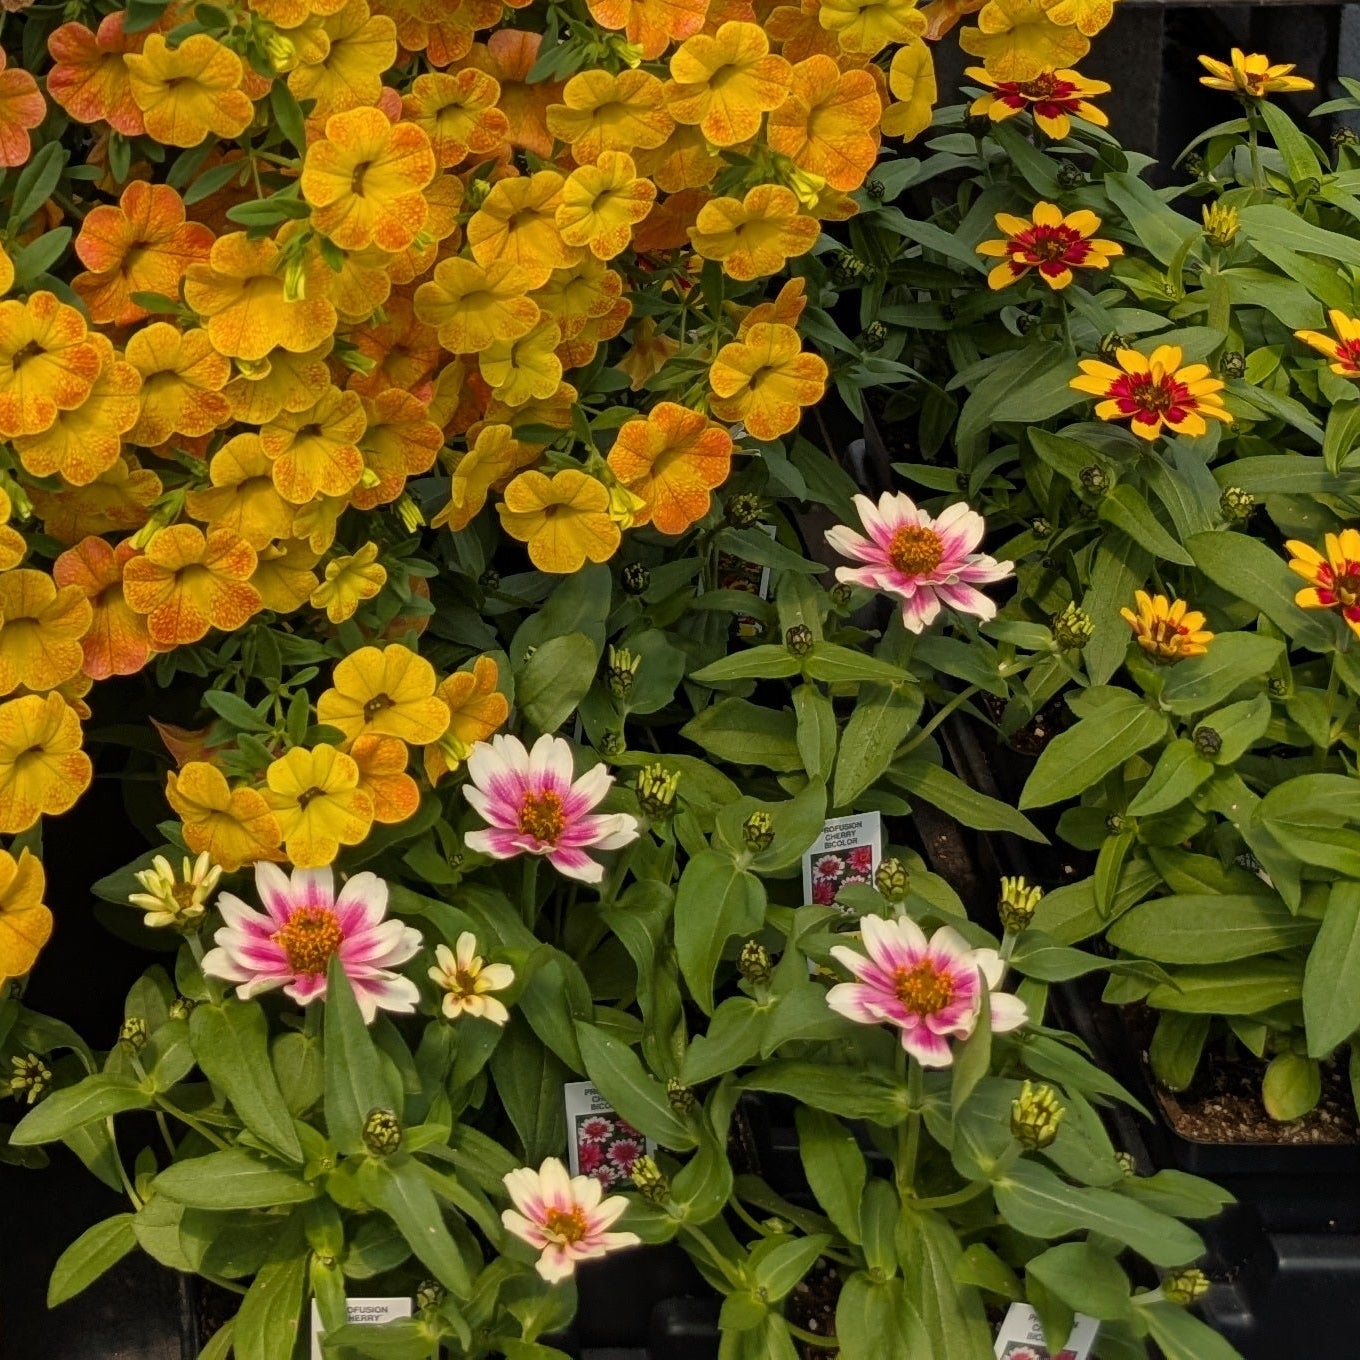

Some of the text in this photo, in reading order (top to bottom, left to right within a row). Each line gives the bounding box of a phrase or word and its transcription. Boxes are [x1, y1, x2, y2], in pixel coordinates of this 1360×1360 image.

[823, 821, 863, 834] ROFUSION
[825, 830, 857, 841] CHERRY
[824, 837, 858, 849] BICOLOR
[591, 1102, 612, 1111] BICO
[347, 1306, 388, 1314] OFUSION
[348, 1314, 382, 1322] HERRY
